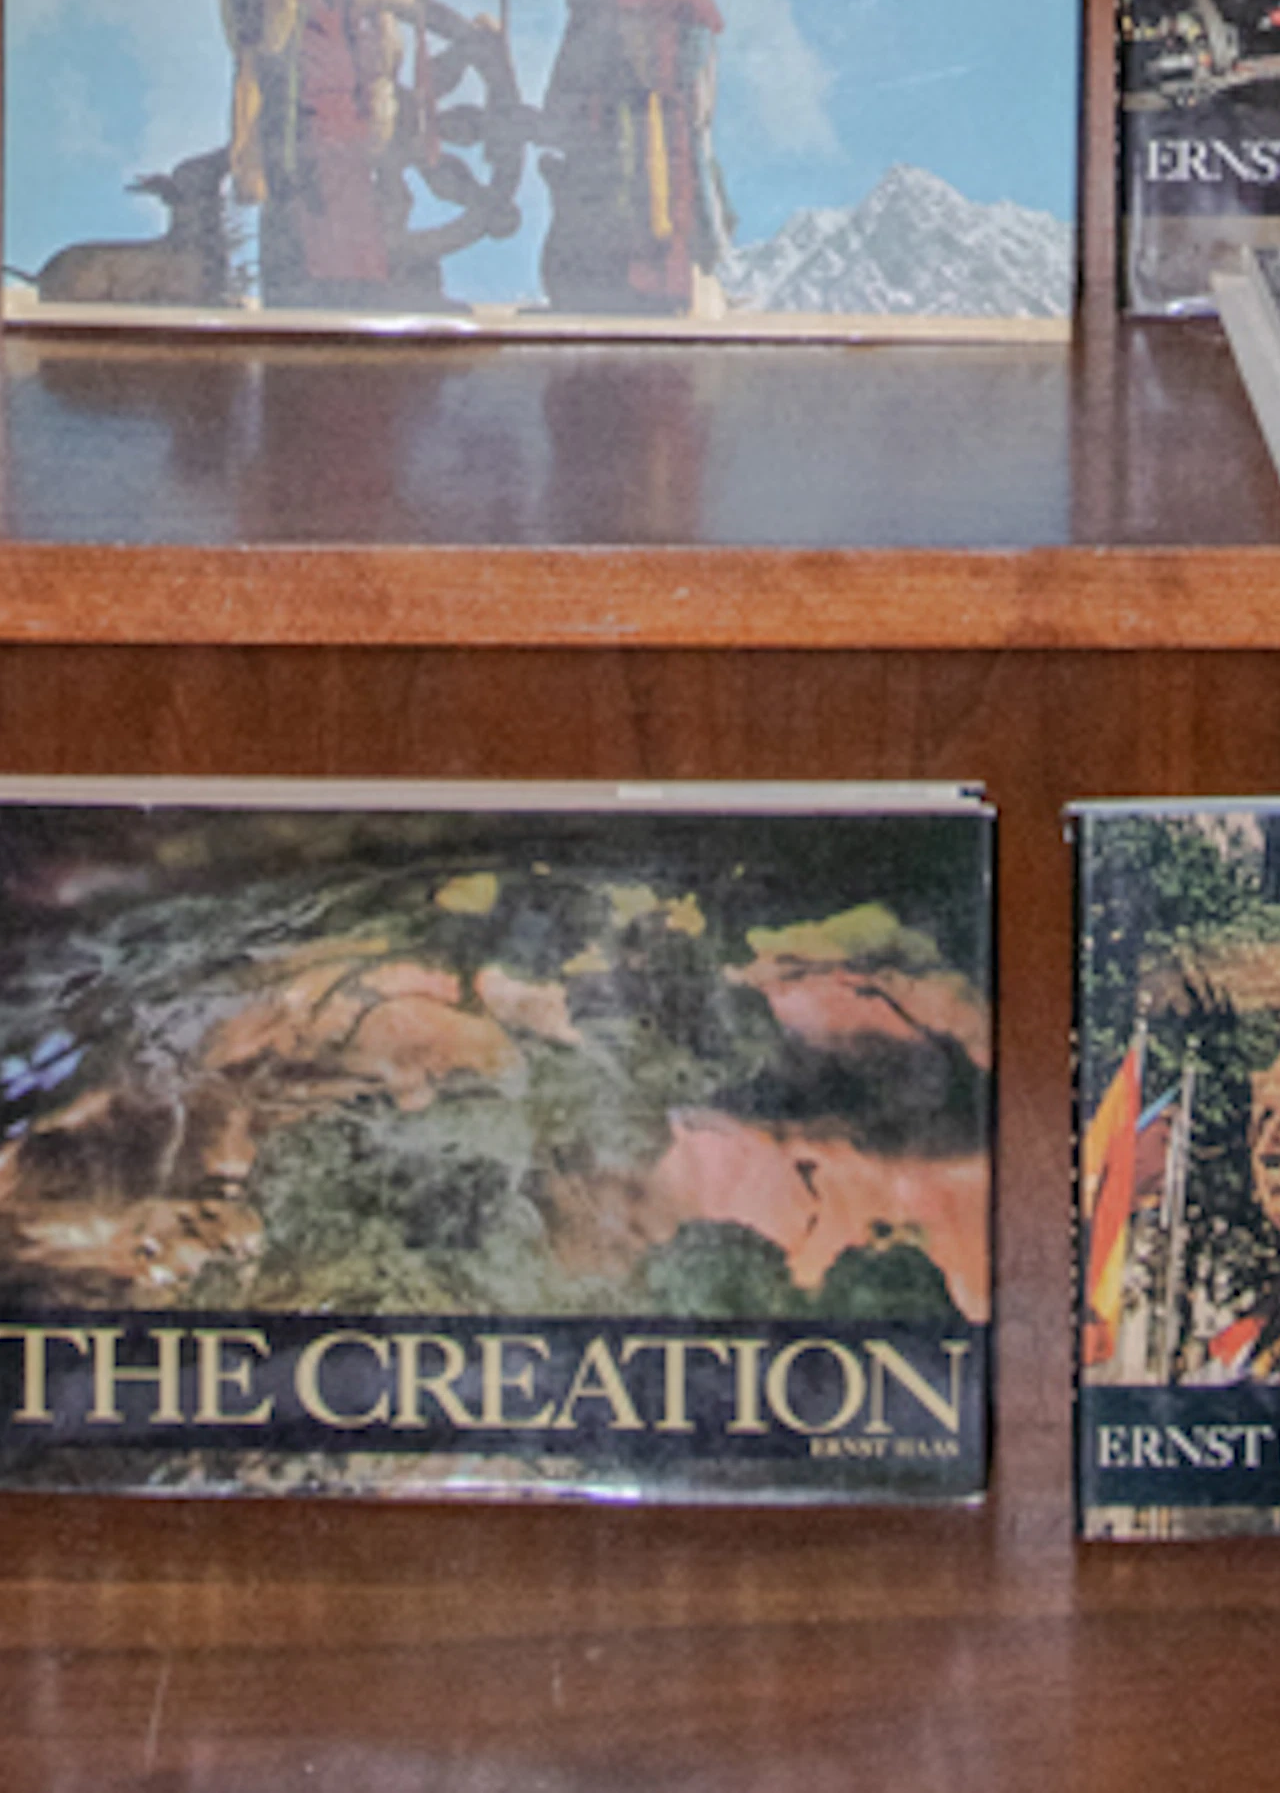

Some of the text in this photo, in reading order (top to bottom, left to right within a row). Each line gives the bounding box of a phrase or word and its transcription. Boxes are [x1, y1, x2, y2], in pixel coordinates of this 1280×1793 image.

[293, 1329, 972, 1436] CREATION
[808, 1435, 891, 1457] ERNST
[1095, 1421, 1274, 1469] ERNST
